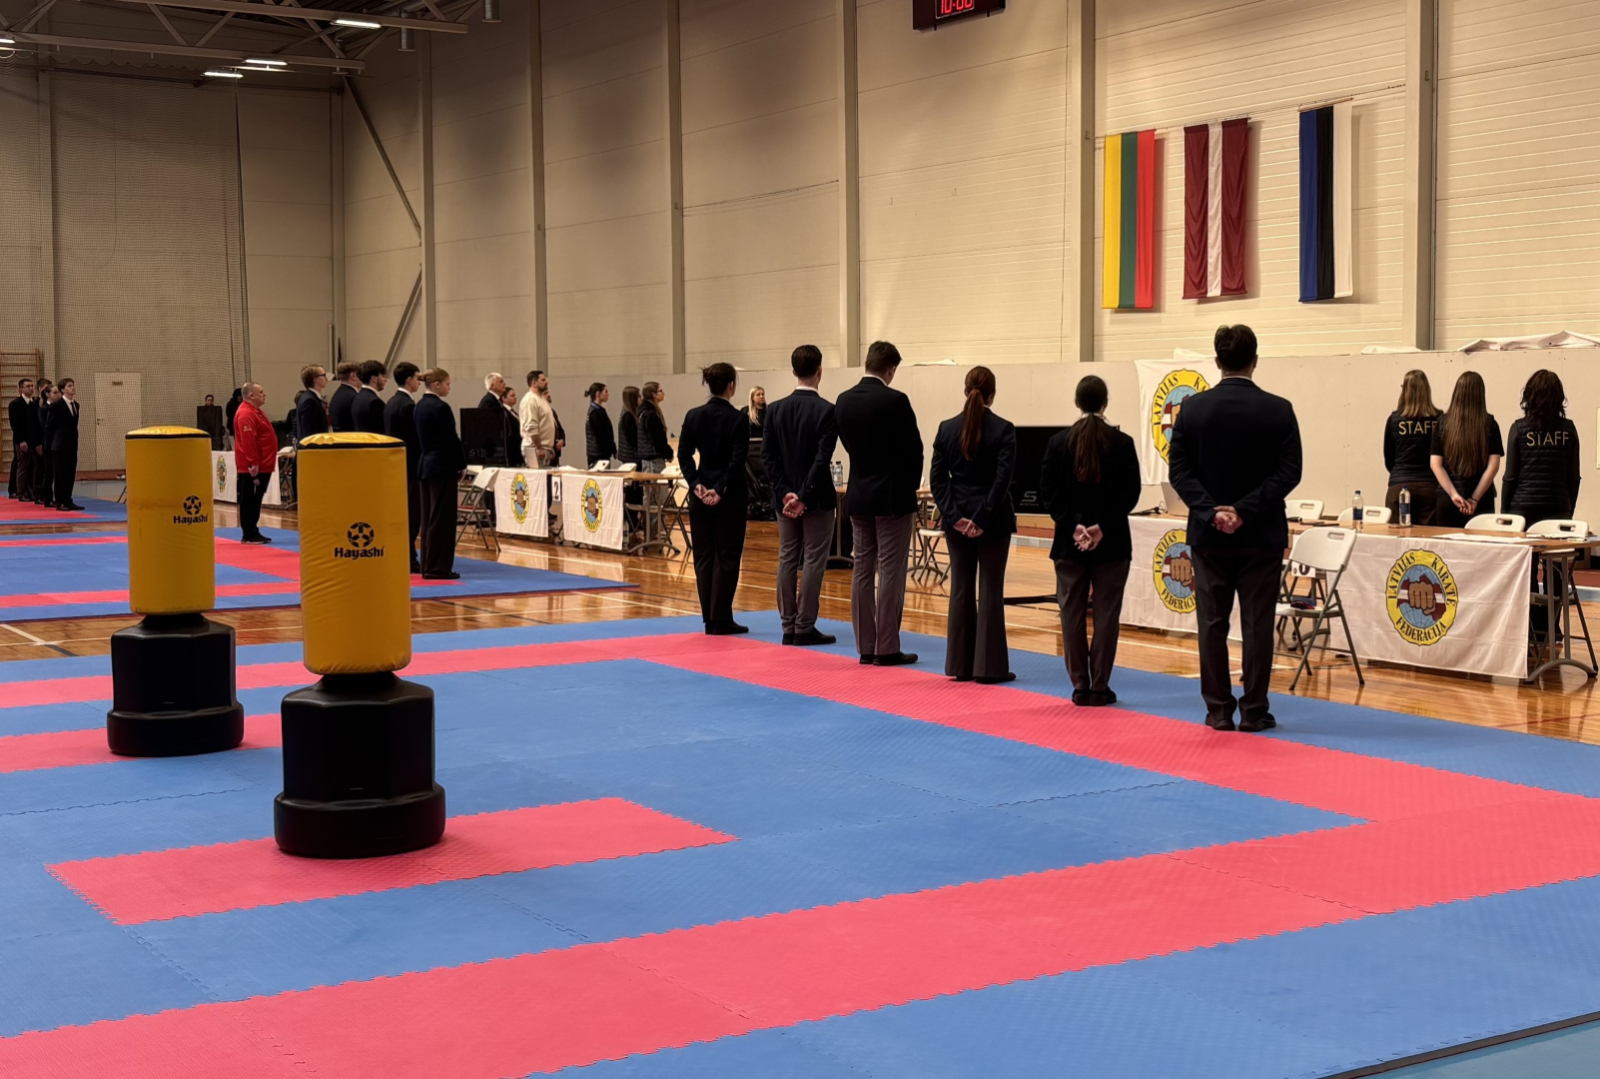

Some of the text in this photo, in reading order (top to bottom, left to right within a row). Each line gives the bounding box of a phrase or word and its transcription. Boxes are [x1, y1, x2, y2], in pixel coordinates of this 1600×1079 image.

[1153, 373, 1179, 426] LATVIJAS
[1398, 420, 1438, 436] STAFF
[1526, 430, 1570, 447] STAFF
[553, 481, 560, 500] 2
[173, 514, 209, 525] Hayashi
[334, 546, 385, 560] Hayashi
[1154, 531, 1178, 574] LATVIJAS
[1387, 552, 1457, 606] LATVIJAS KARATE
